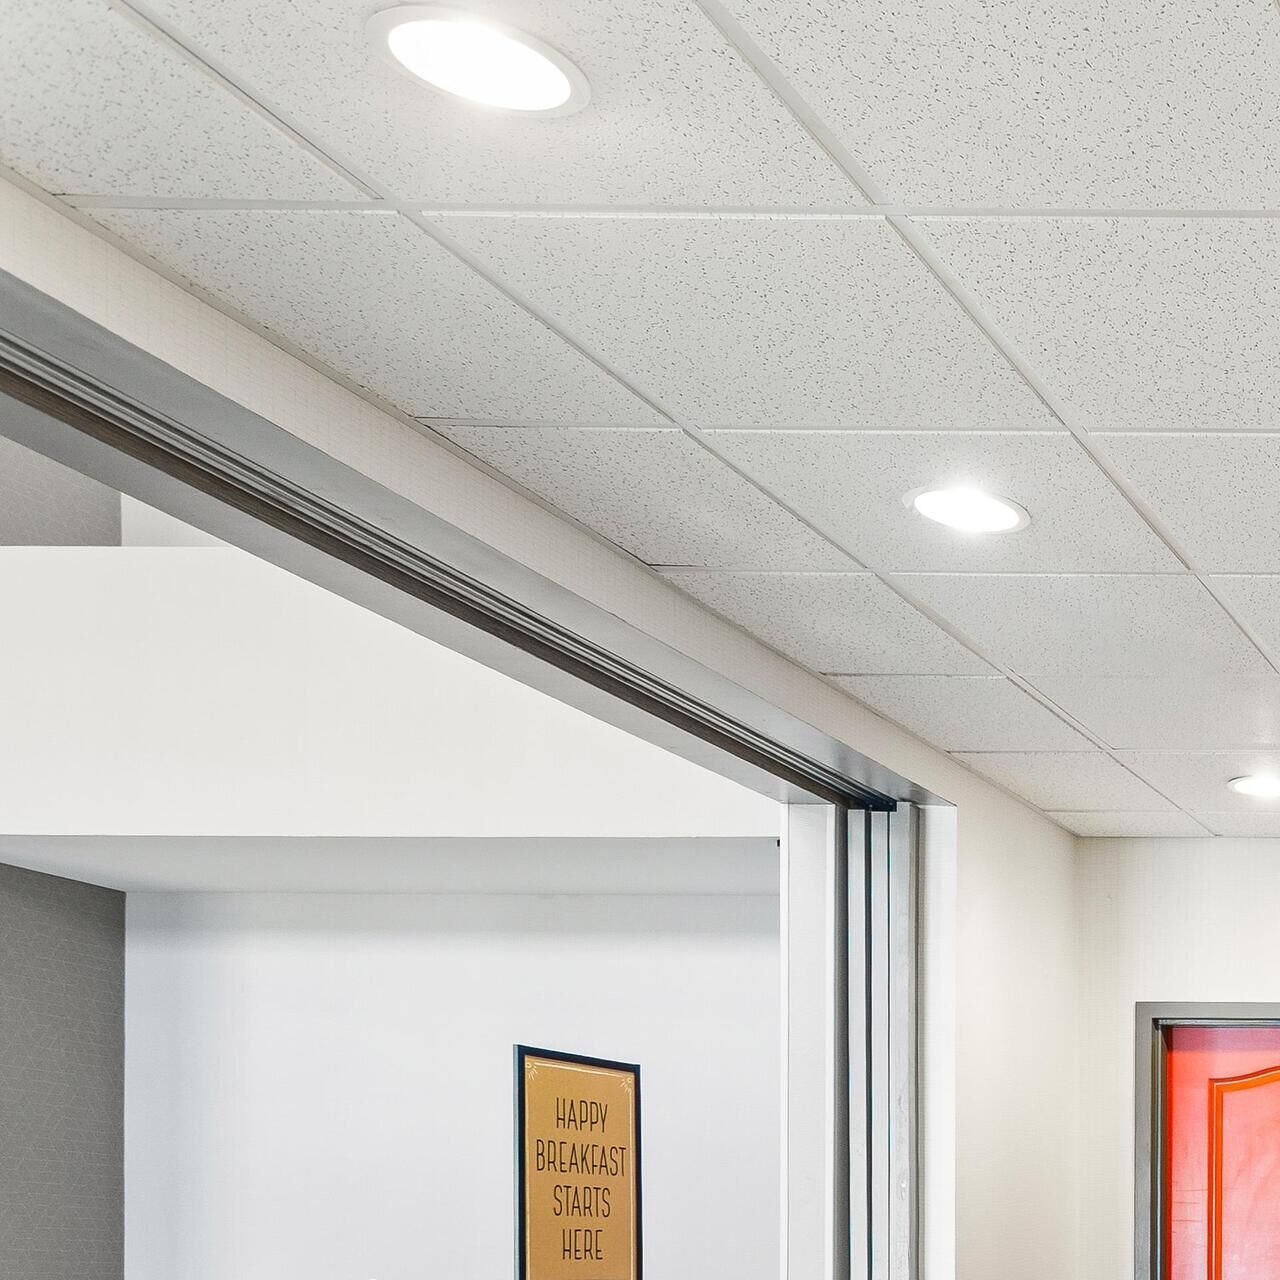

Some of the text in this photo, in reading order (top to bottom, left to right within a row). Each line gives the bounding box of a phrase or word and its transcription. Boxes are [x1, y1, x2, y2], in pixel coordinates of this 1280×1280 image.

[556, 1097, 608, 1133] HAPPY
[536, 1139, 627, 1176] BREAKFAST
[553, 1184, 611, 1218] STARTS
[562, 1229, 603, 1260] HERE
